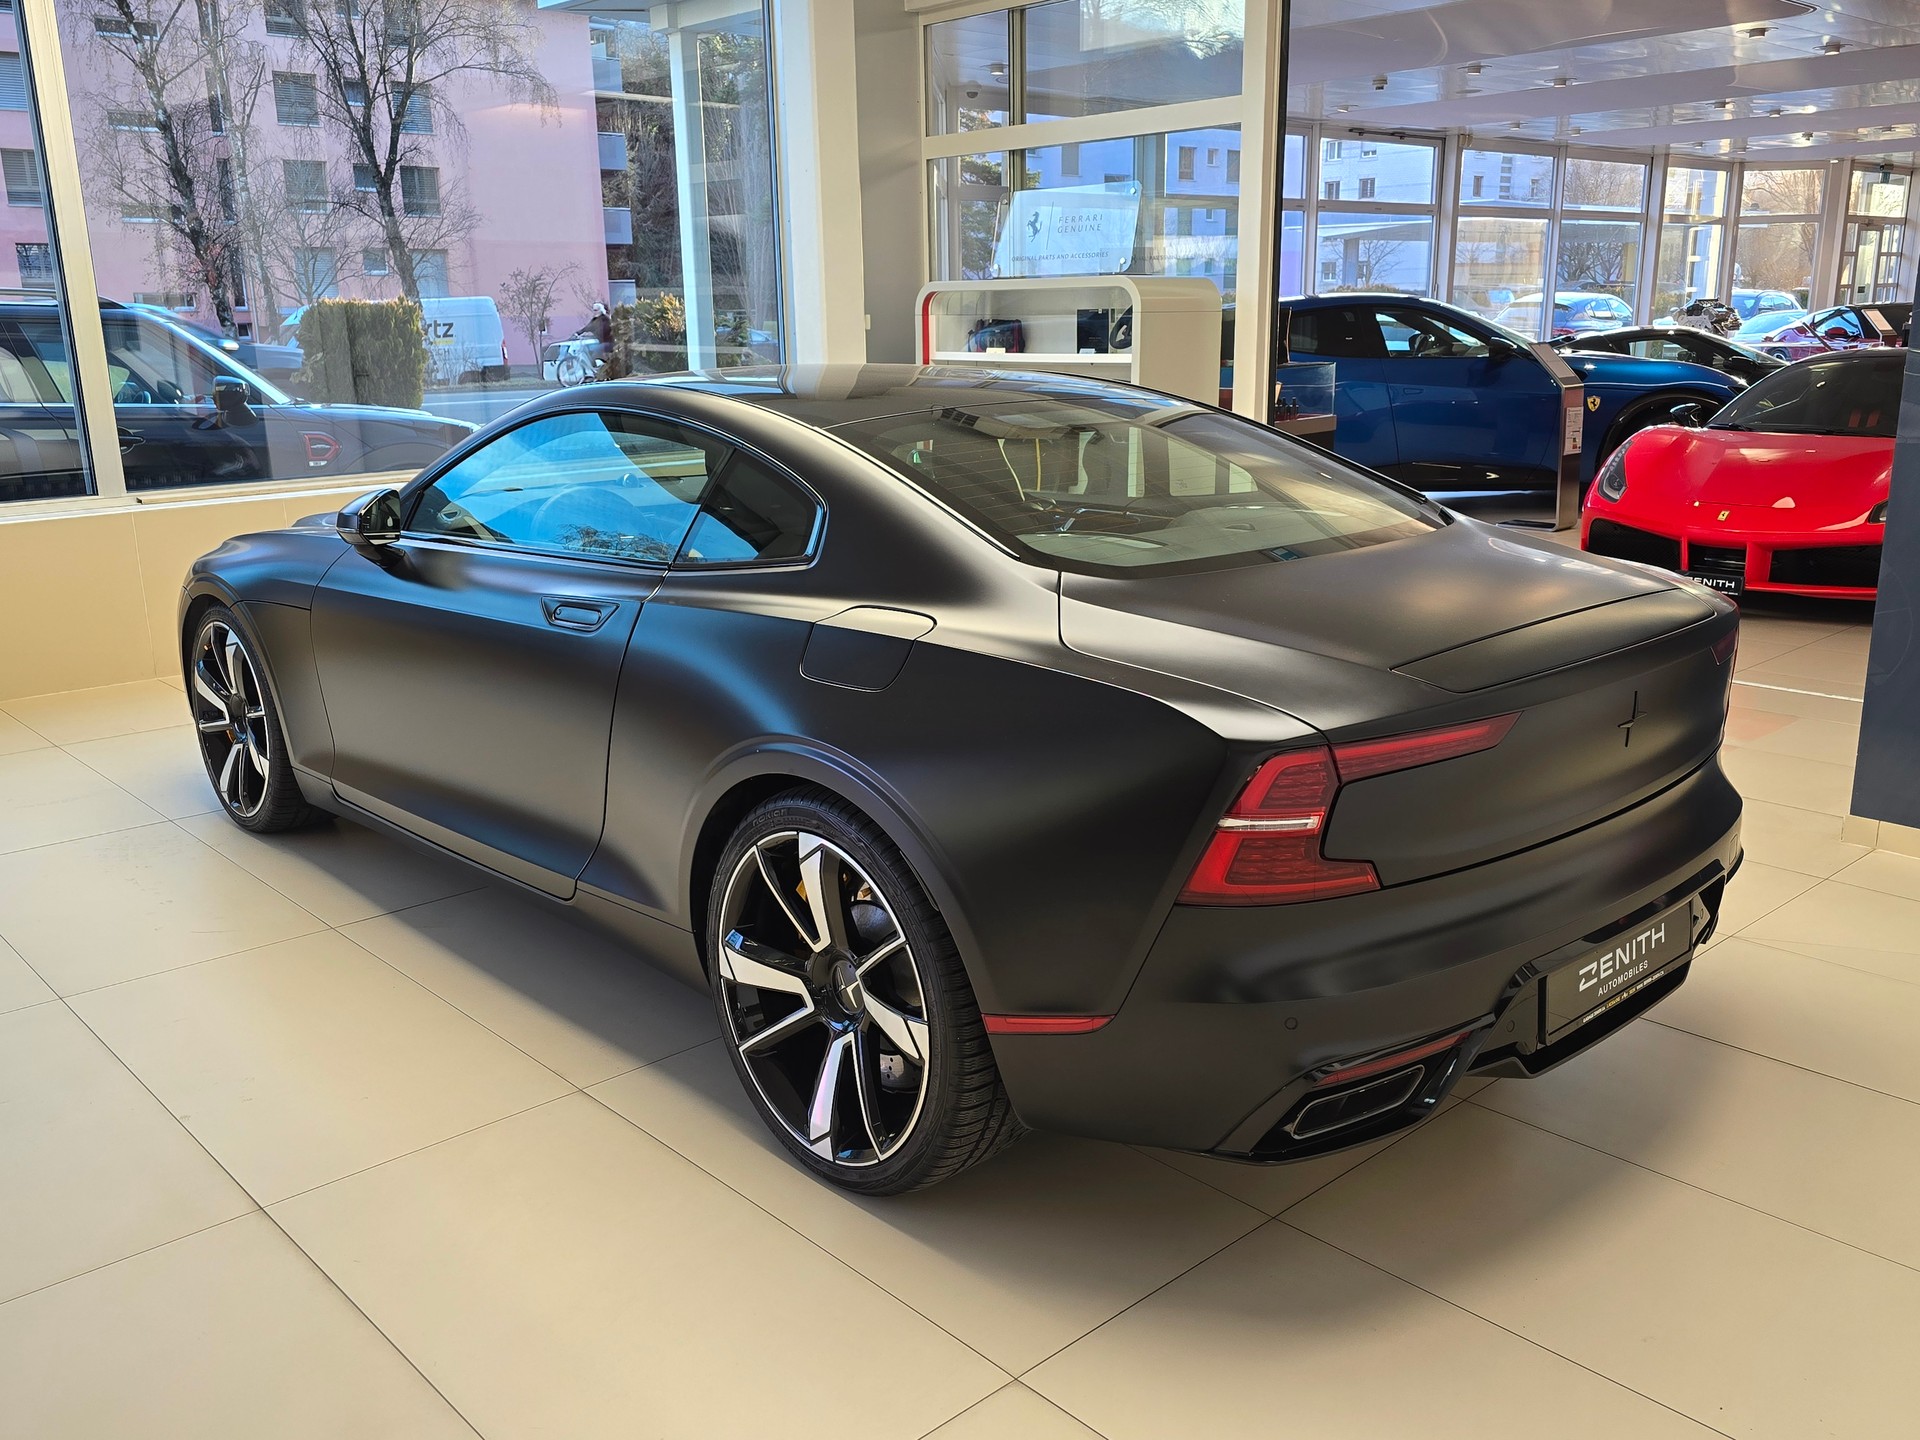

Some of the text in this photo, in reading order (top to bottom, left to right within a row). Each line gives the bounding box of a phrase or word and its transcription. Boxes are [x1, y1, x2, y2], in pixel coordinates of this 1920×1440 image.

[1058, 213, 1103, 224] FERRARI
[1057, 223, 1101, 234] GENUINE
[1070, 251, 1109, 259] ACCESSORIES
[1578, 922, 1665, 992] ZENITH
[1598, 959, 1649, 997] AUTOMOBILES
